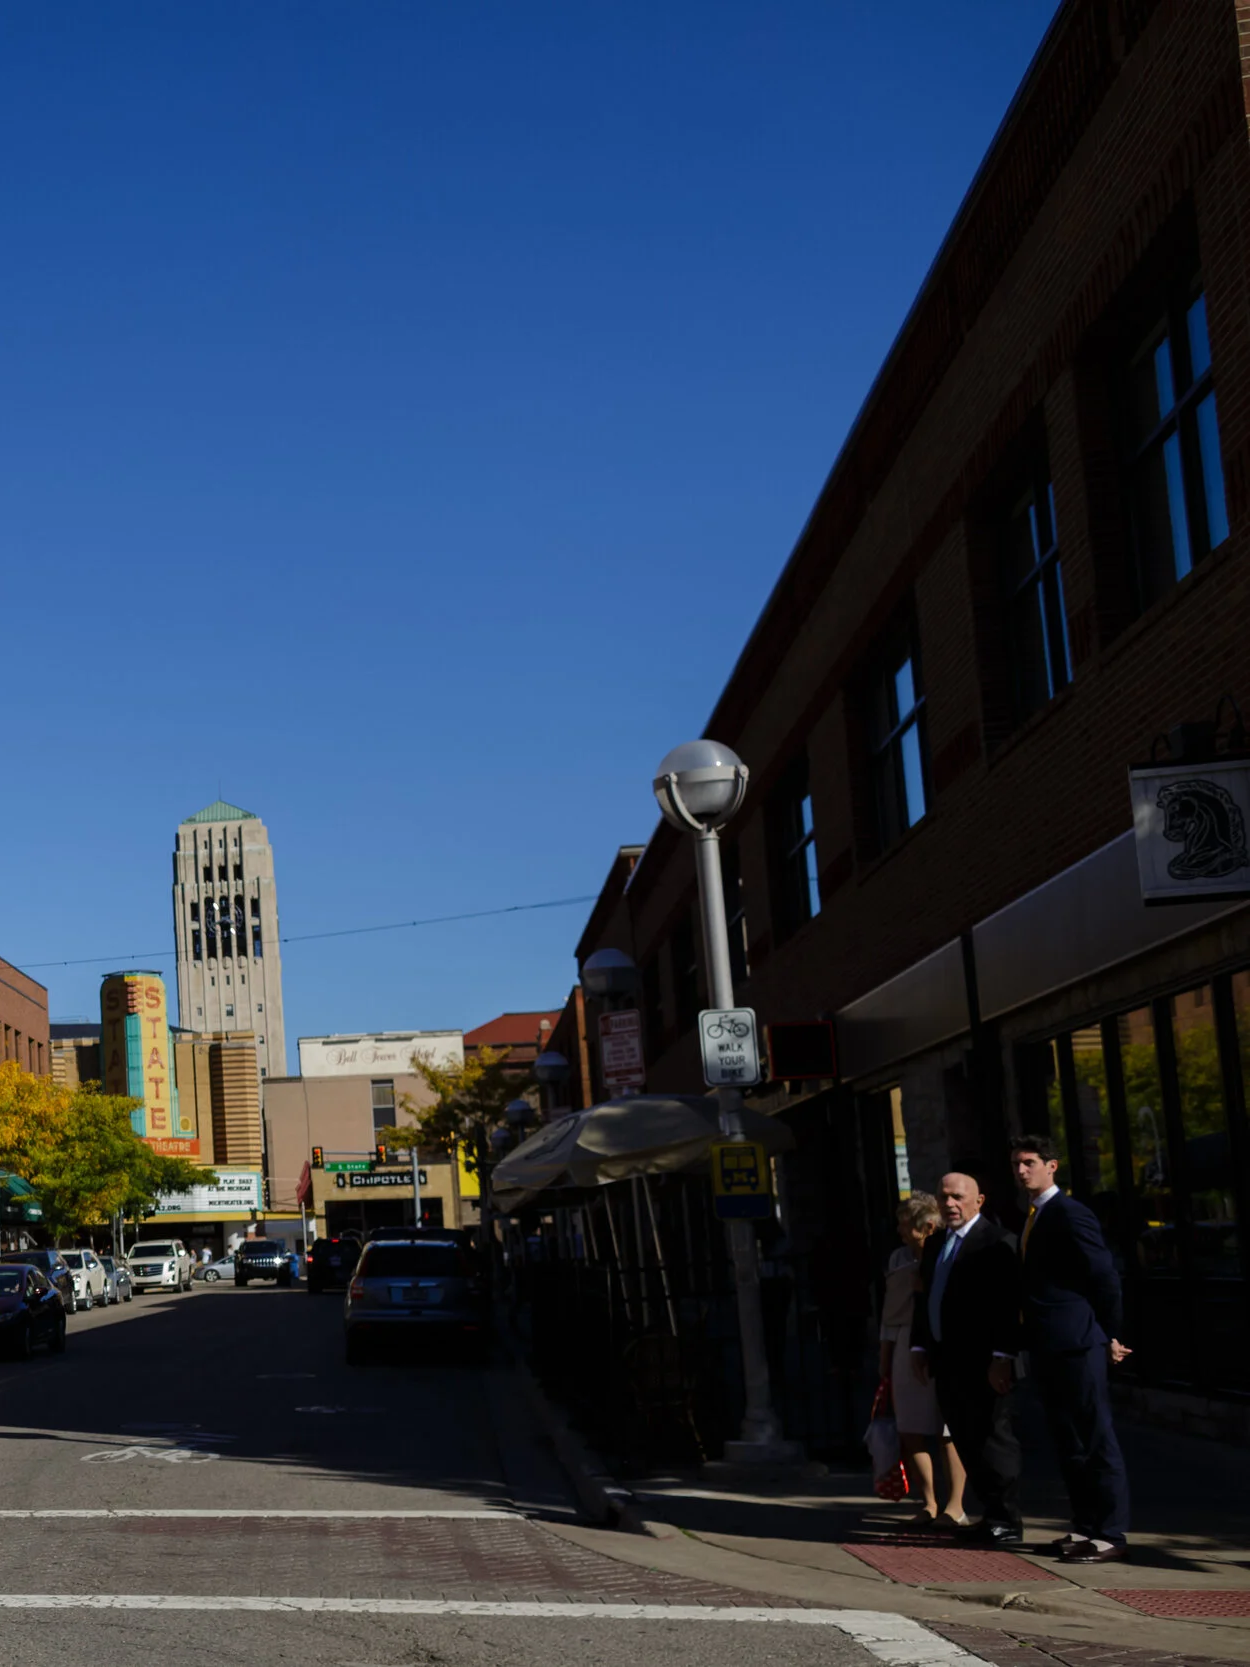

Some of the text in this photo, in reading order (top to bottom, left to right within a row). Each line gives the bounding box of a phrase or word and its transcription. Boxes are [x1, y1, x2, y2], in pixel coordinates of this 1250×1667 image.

[106, 988, 122, 1097] STAT
[717, 1042, 743, 1052] WALK
[145, 987, 166, 1129] STATE
[326, 1046, 358, 1065] Bell
[718, 1055, 746, 1065] YOUR
[721, 1067, 745, 1079] BIKE
[152, 1141, 190, 1153] THEATRE
[352, 1175, 412, 1185] CHIPOTLE
